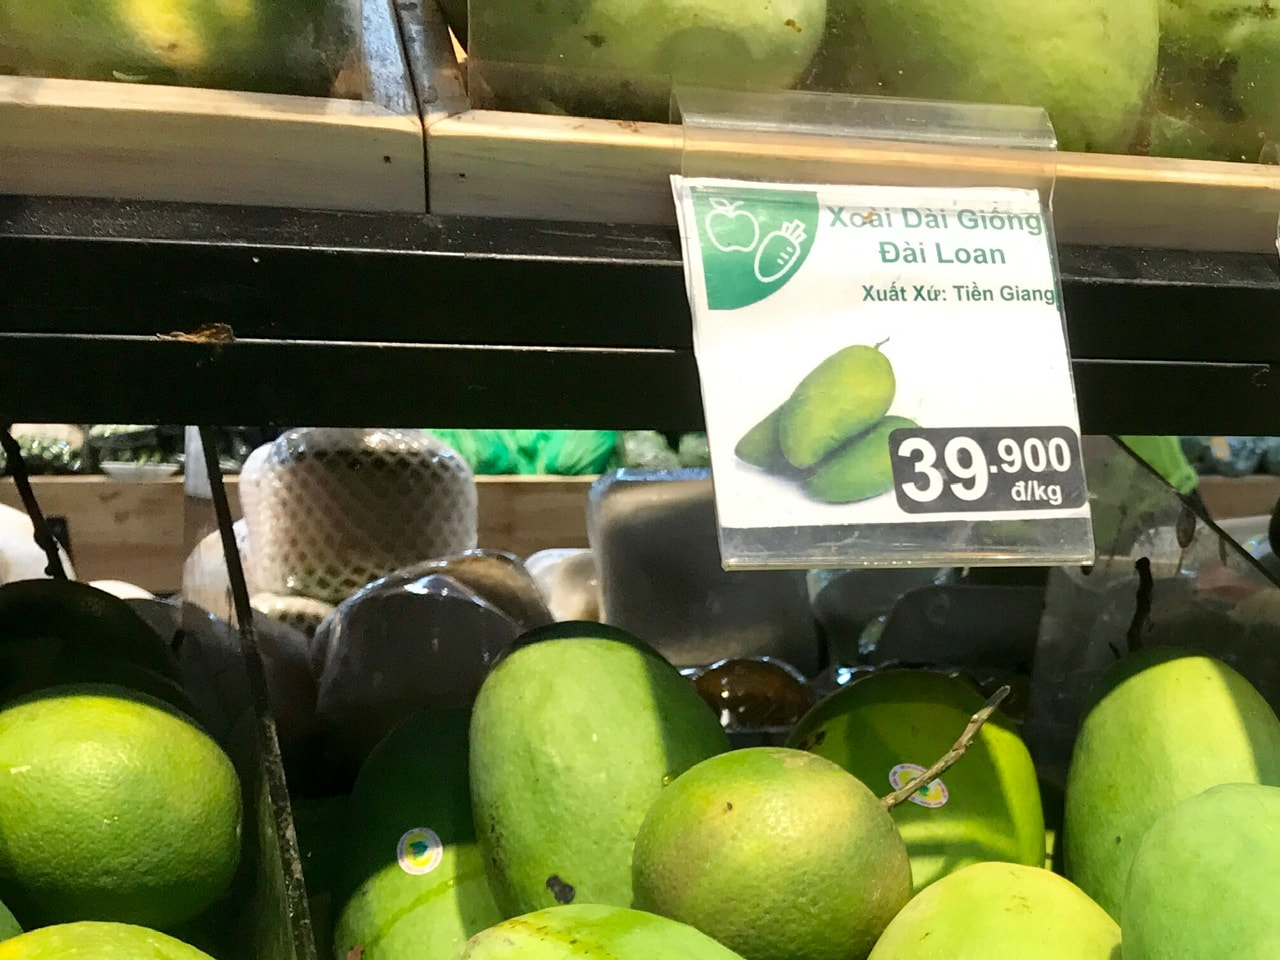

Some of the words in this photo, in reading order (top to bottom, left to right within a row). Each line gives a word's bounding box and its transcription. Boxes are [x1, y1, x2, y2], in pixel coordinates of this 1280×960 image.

[826, 205, 893, 229] Xoài
[901, 206, 949, 230] Dài
[956, 206, 1044, 237] Giống
[878, 240, 927, 264] Đài
[934, 241, 1007, 265] Loan
[861, 280, 908, 302] Xuất
[911, 284, 948, 302] Xứ:
[952, 280, 994, 302] Tiền
[999, 284, 1056, 306] Giang
[1010, 479, 1064, 506] đ/kg
